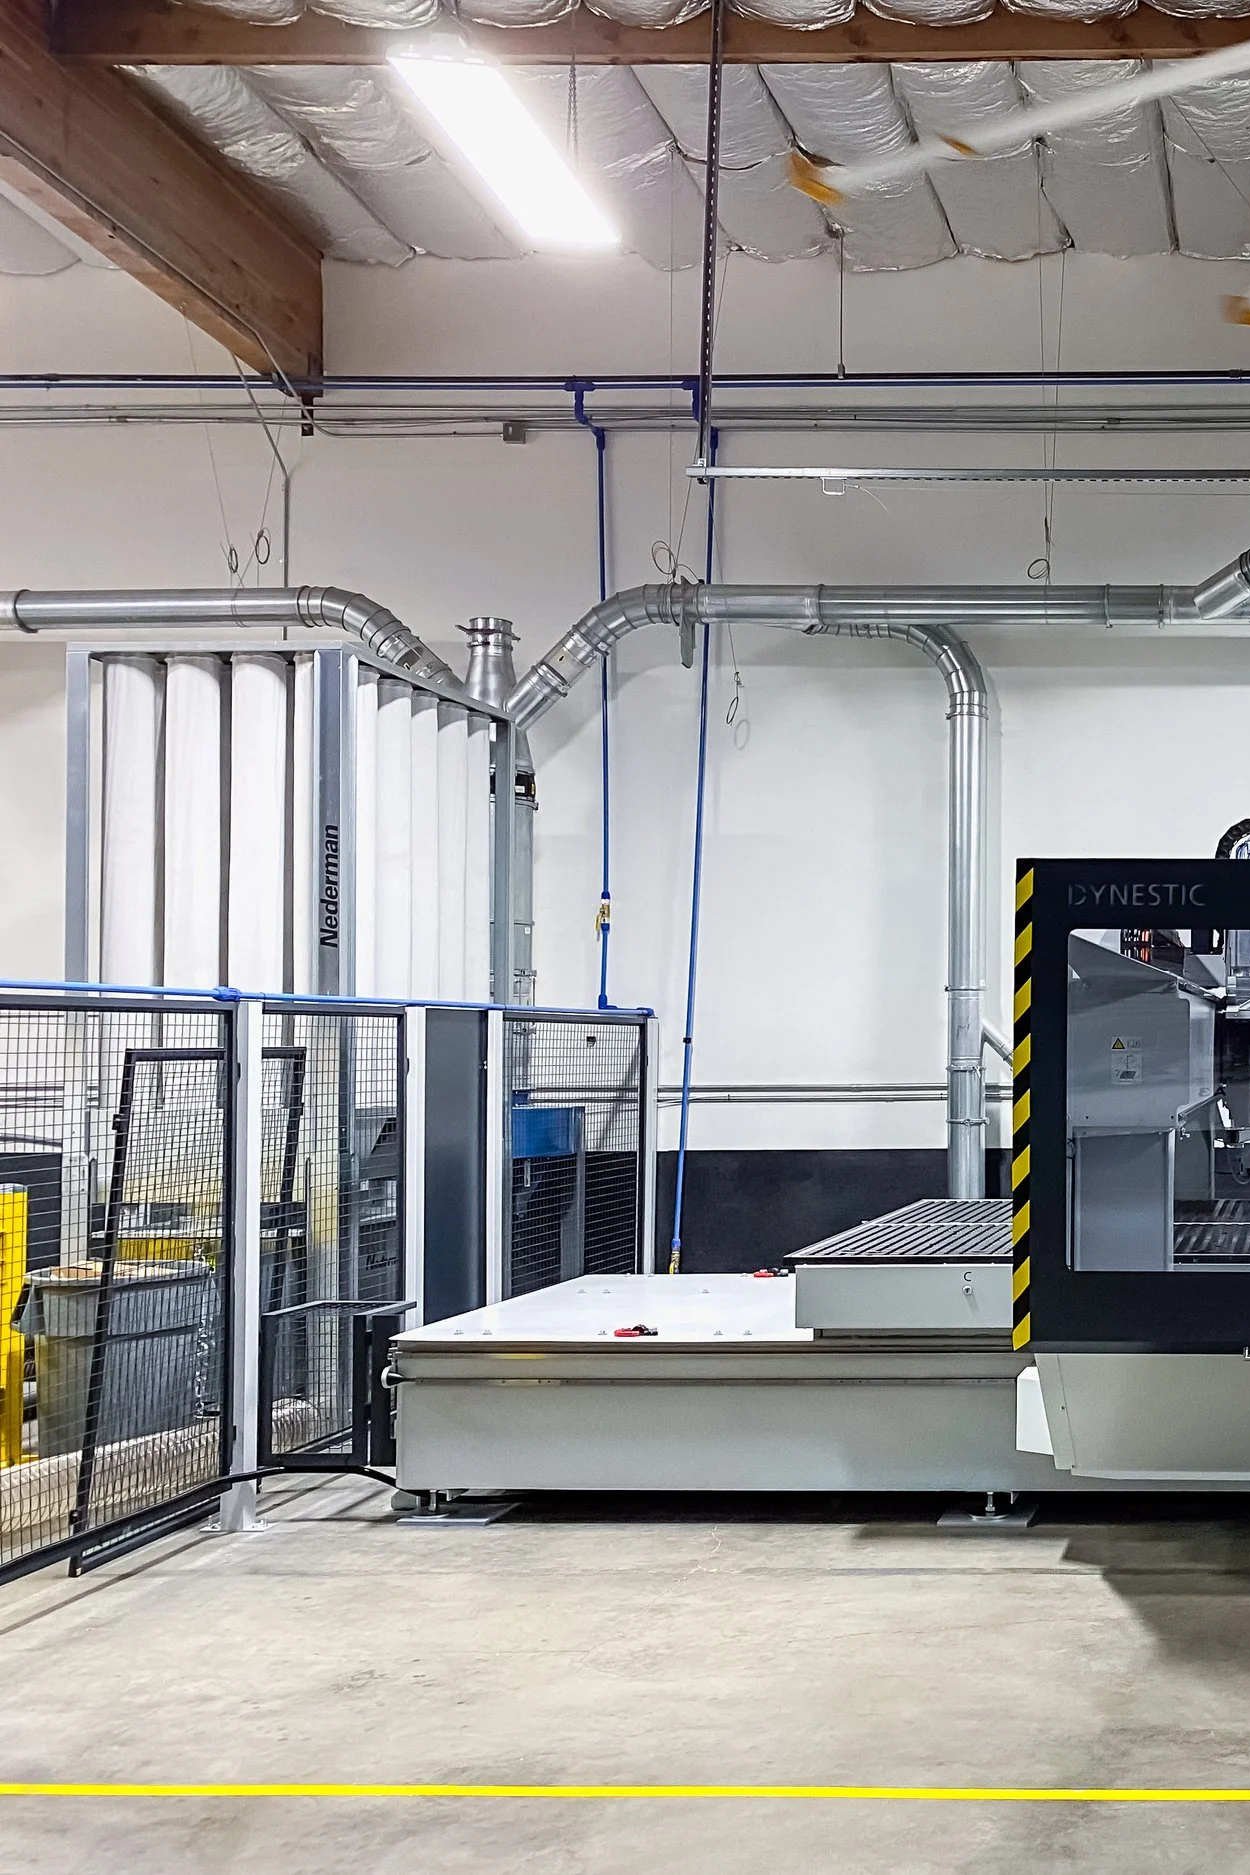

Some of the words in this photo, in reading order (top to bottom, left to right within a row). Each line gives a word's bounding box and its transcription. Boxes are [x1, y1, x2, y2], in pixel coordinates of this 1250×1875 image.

[320, 824, 339, 949] Nederman
[1067, 883, 1206, 906] DYNESTIC
[963, 1271, 972, 1282] C
